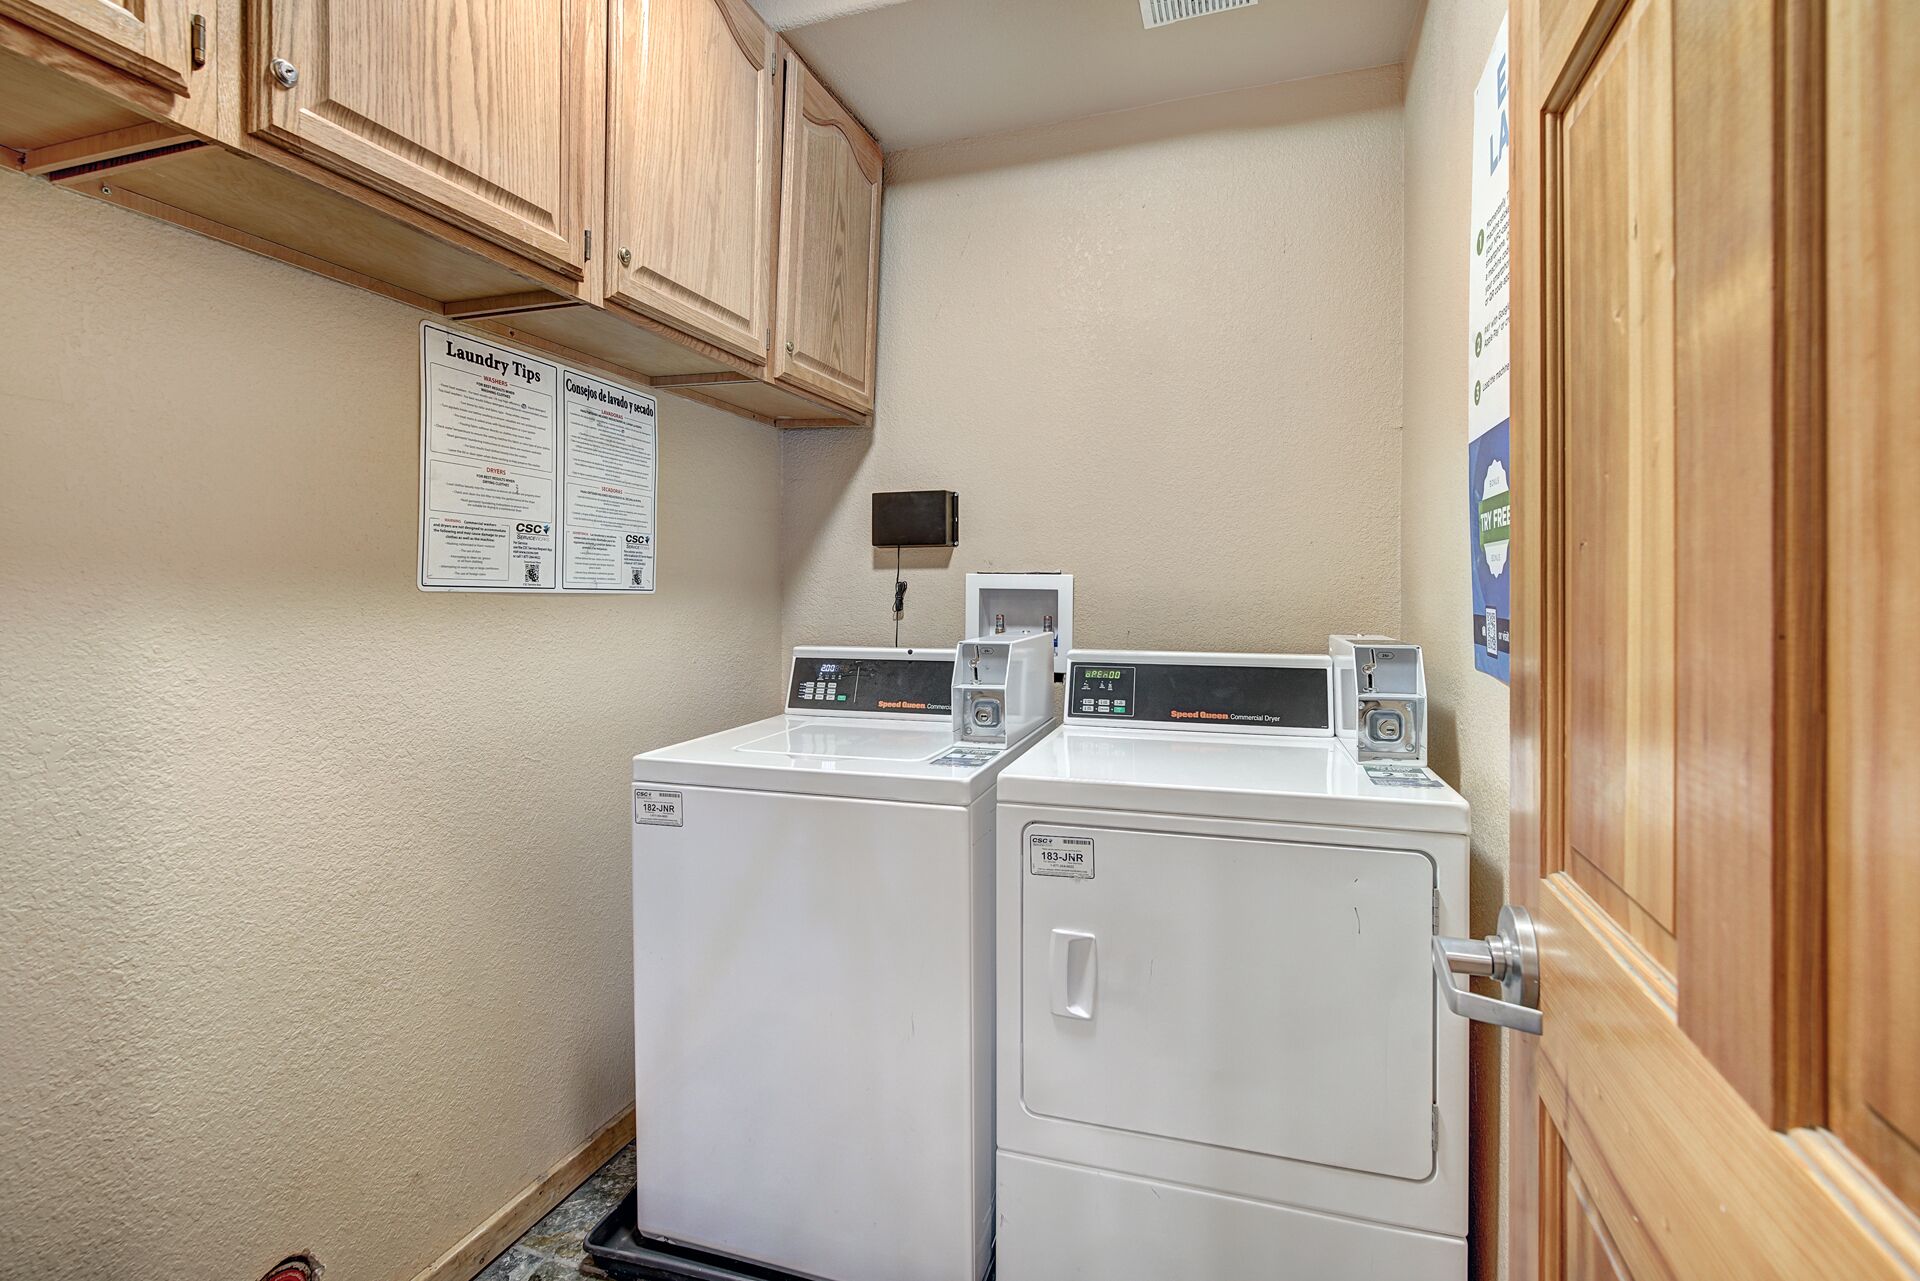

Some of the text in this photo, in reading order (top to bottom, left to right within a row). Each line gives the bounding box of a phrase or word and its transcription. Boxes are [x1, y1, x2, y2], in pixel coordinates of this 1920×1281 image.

[1497, 53, 1508, 110] E
[446, 340, 541, 384] Laundry Tips
[483, 375, 508, 387] WASHERS
[566, 378, 654, 417] Consejos de lavado y secado
[486, 467, 506, 476] DRYERS
[1481, 505, 1510, 532] TRY FREE
[516, 523, 542, 534] CSC
[626, 534, 645, 544] CSC
[1171, 710, 1281, 723] Speed Queen Commercial Dryer
[643, 804, 675, 813] 182-JNR
[1042, 852, 1084, 862] 183-JNR
